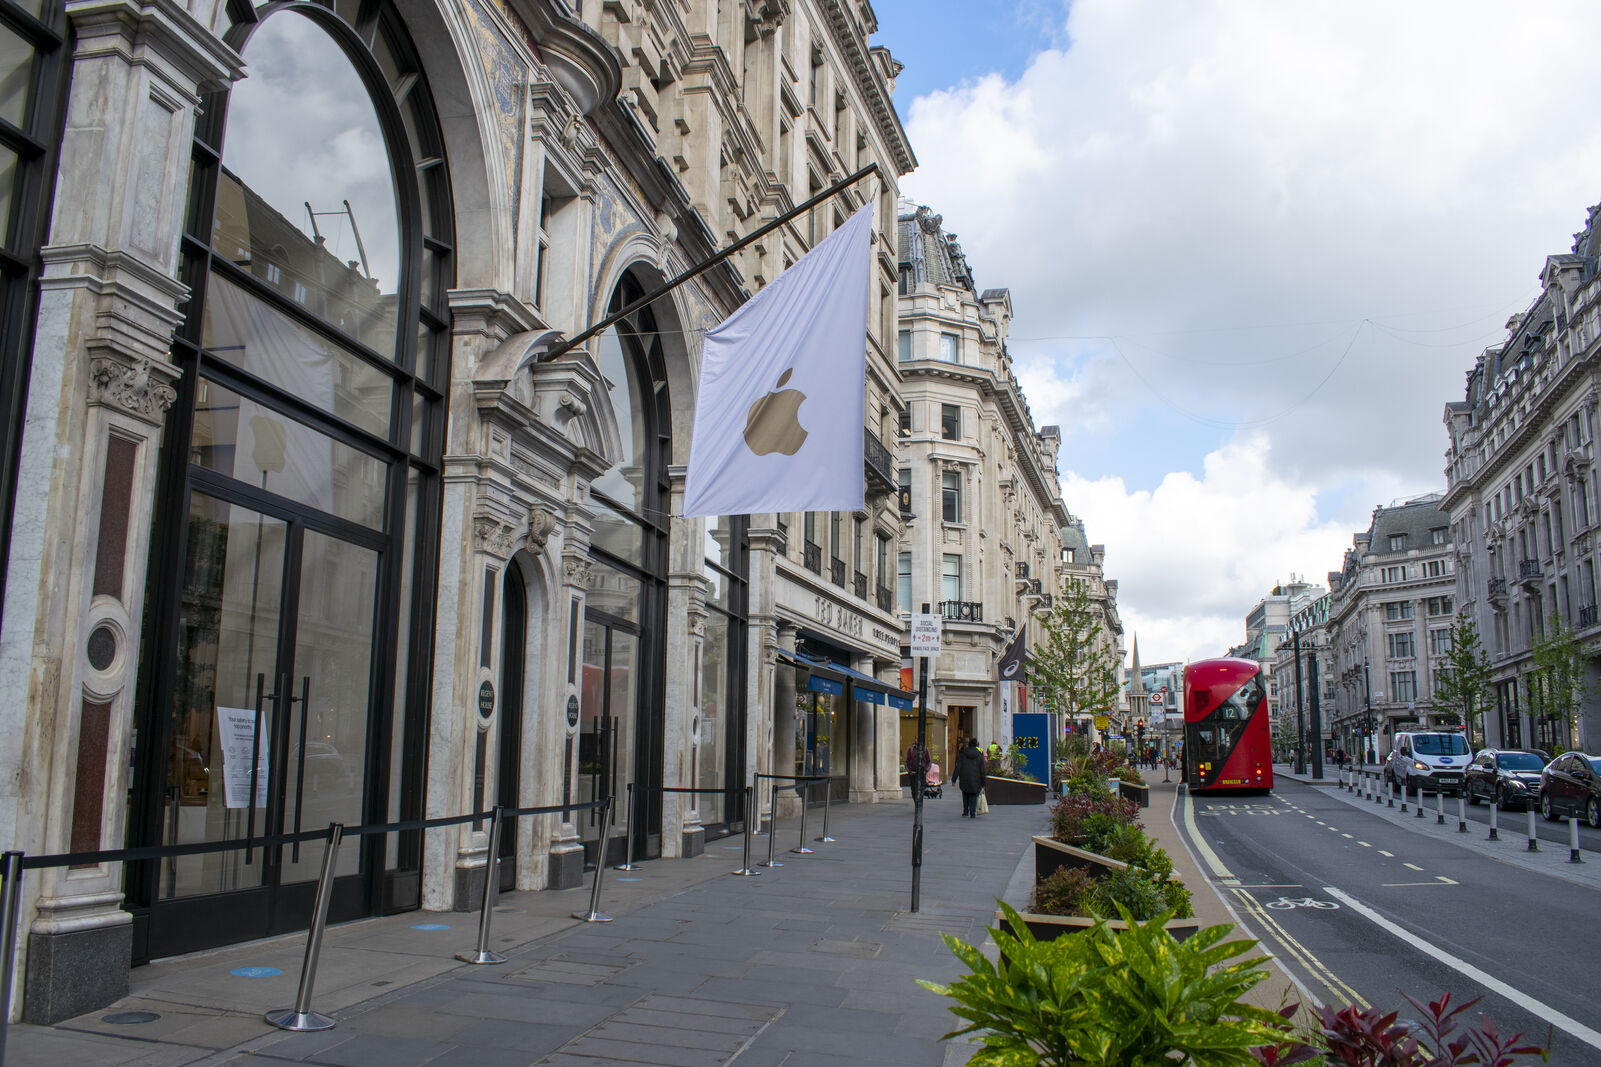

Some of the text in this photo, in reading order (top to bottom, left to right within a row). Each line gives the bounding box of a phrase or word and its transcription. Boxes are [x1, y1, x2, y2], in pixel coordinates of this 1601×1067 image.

[814, 596, 863, 638] TED BAKER
[921, 633, 931, 642] 2m
[480, 689, 493, 698] REGENT
[480, 701, 493, 709] HOUSE
[1225, 708, 1235, 718] 12
